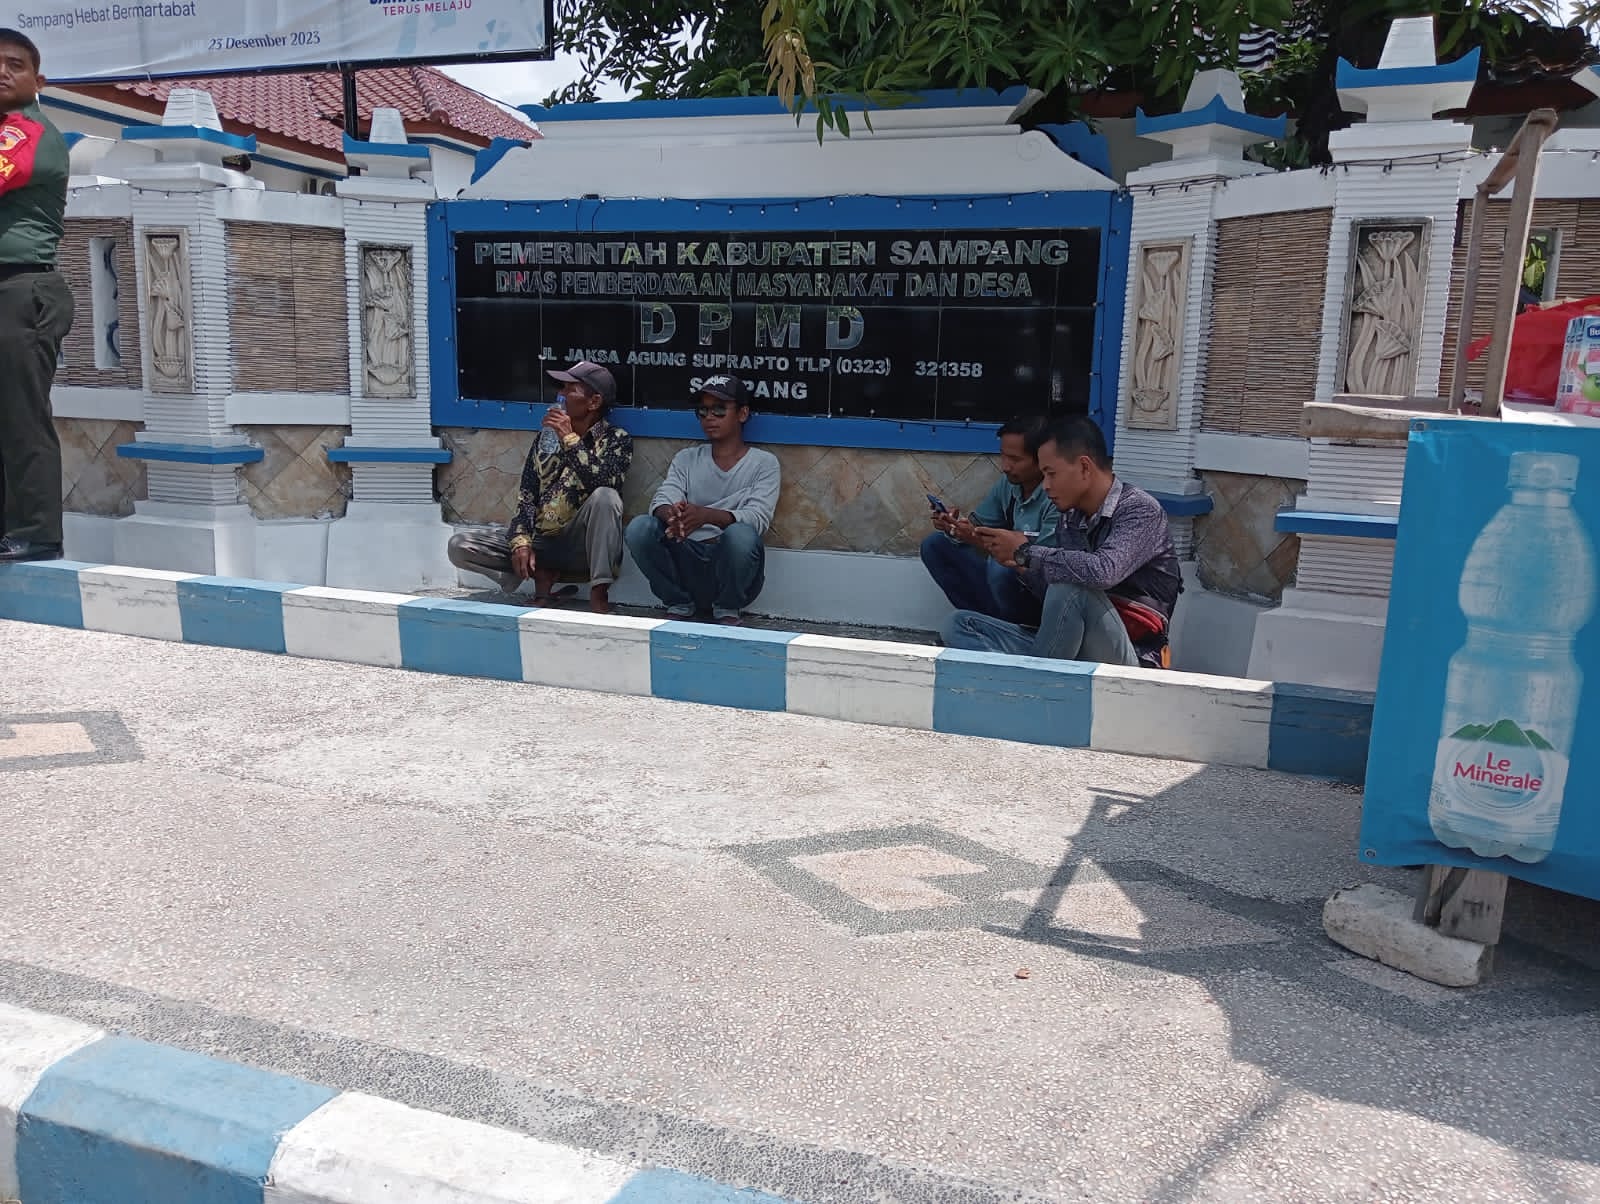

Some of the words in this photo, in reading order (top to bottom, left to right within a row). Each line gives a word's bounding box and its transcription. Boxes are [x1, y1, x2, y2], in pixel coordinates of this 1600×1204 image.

[18, 13, 74, 30] Sampang
[75, 8, 111, 24] Hebat
[112, 1, 196, 20] Bermartabat
[382, 4, 421, 16] TERUS
[425, 0, 472, 13] MELAJU
[208, 38, 226, 50] 23
[226, 34, 288, 50] Desember
[290, 31, 321, 46] 2023
[474, 241, 667, 265] PEMERINTAH
[677, 240, 876, 266] KABUPATEN
[890, 239, 1070, 265] SAMPANG
[495, 270, 557, 294] DINAS
[562, 271, 731, 296] PEMBERDAYAAN
[736, 272, 899, 297] MASYARAKAT
[904, 272, 958, 297] DAN
[963, 272, 1033, 297] DESA
[538, 347, 557, 360] JL
[564, 348, 620, 364] JAKSA
[626, 351, 687, 367] AGUNG
[692, 353, 790, 371] SUPRAPTO
[795, 357, 831, 373] TLP
[836, 357, 892, 376] (0323)
[914, 361, 984, 378] 321358
[689, 377, 808, 399] SPANG
[1486, 752, 1511, 772] Le
[1453, 761, 1542, 791] Minerale
